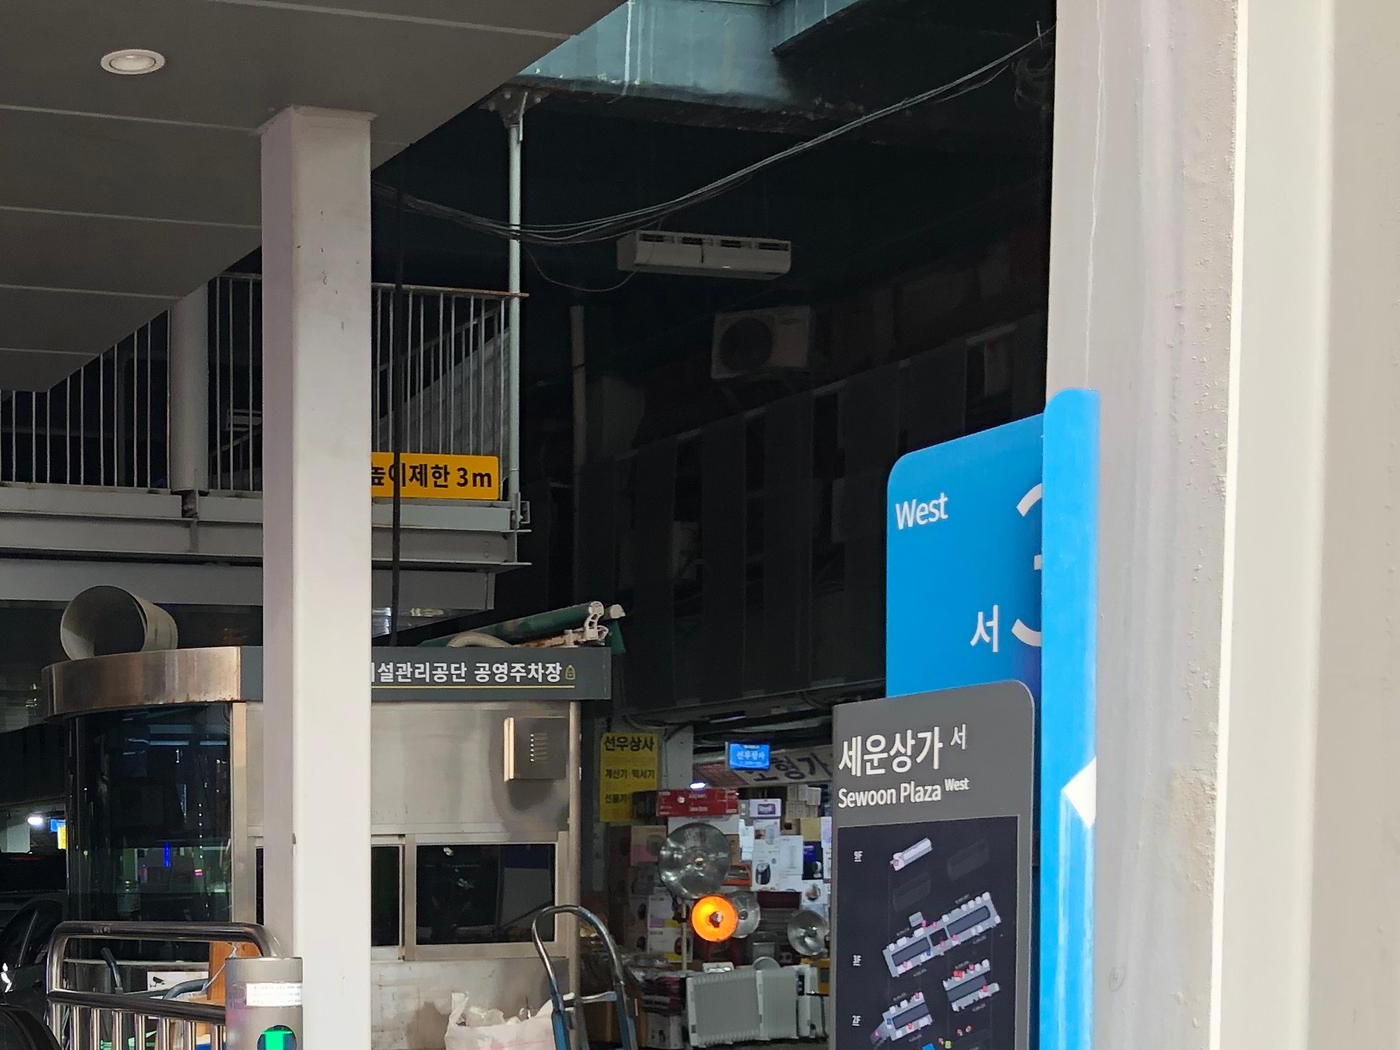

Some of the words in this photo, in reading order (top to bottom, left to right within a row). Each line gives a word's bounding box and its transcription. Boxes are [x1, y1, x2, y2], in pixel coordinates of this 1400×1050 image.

[457, 467, 492, 488] 3m
[895, 492, 949, 530] West
[970, 604, 999, 653] 서
[474, 662, 562, 683] 공영주차장
[604, 736, 655, 752] 선우상사
[838, 726, 943, 777] 세운상가
[950, 723, 967, 750] 서
[838, 787, 897, 808] Sewoon
[900, 780, 942, 803] Plaza
[944, 777, 970, 791] West
